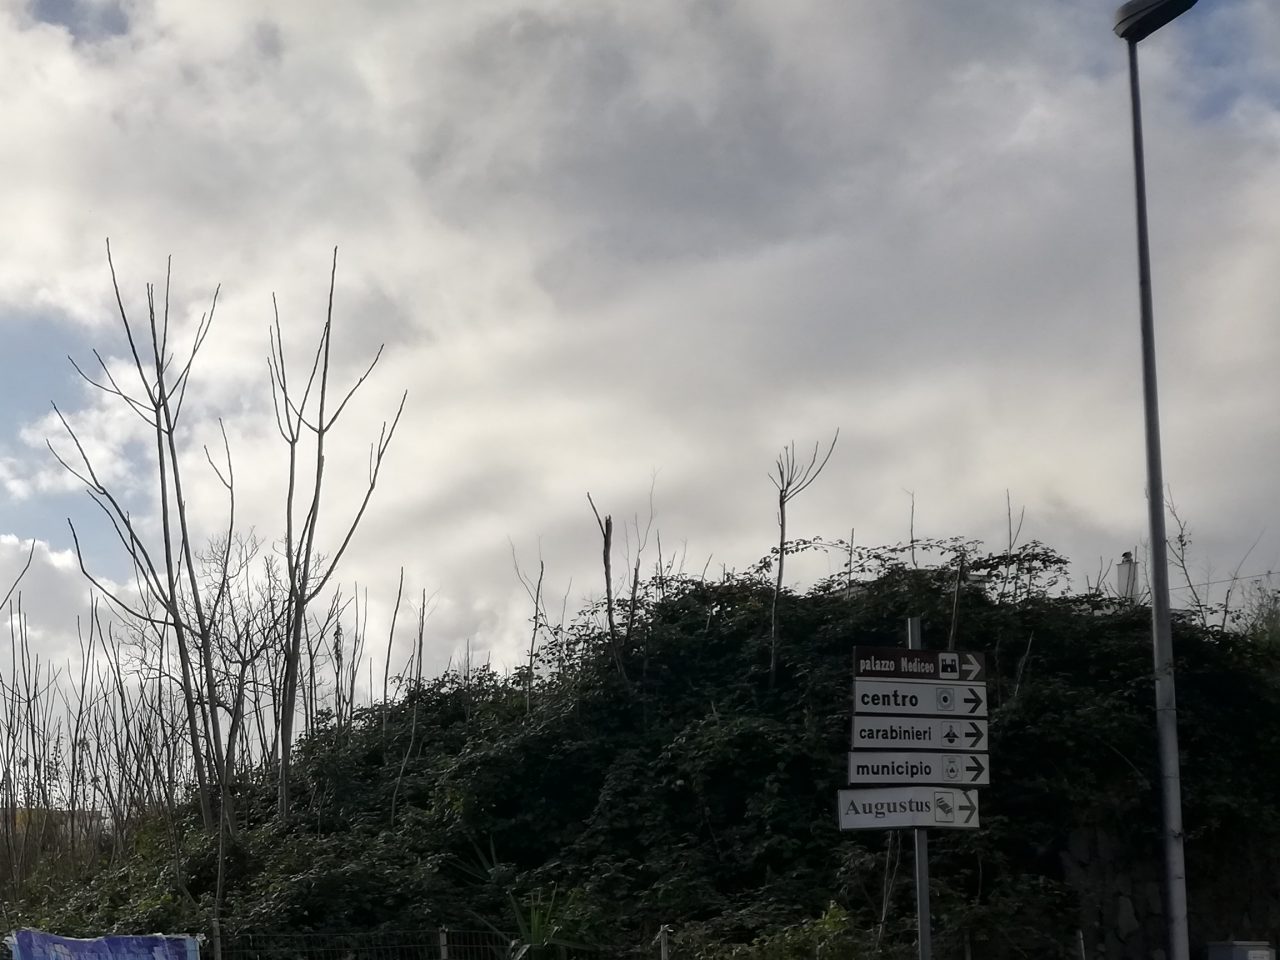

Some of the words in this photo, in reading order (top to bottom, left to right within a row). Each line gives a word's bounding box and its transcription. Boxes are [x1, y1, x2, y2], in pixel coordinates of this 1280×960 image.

[859, 655, 895, 673] palazzo
[861, 689, 918, 708] centro
[859, 725, 932, 742] carabinieri
[856, 760, 932, 778] municipio
[845, 797, 931, 818] Augustus
